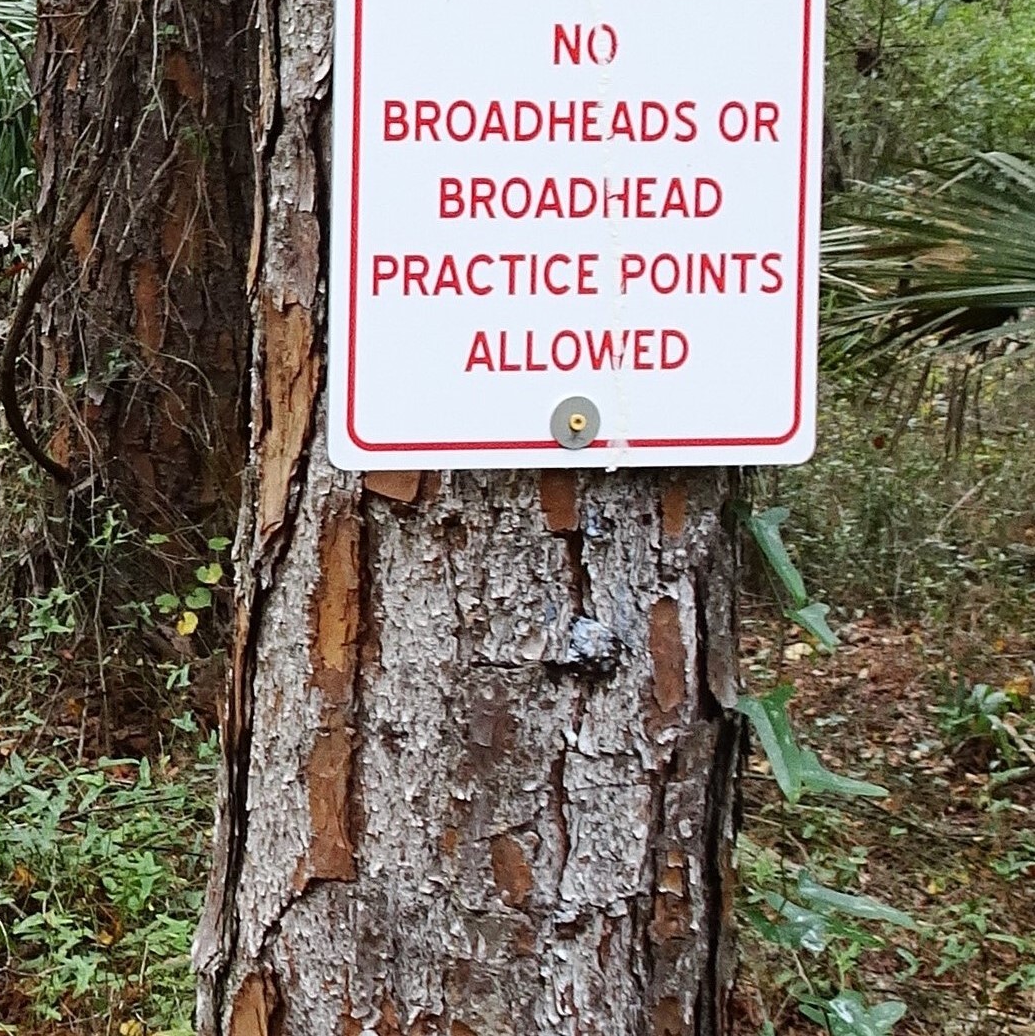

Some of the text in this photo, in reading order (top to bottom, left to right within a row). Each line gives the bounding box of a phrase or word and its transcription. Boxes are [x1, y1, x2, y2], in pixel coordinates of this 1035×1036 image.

[553, 24, 618, 65] NO
[383, 100, 780, 143] BROADHEADS OR
[439, 177, 722, 219] BROADHEAD
[372, 252, 784, 296] PRACTICE POINTS
[466, 329, 690, 372] ALLOWED
